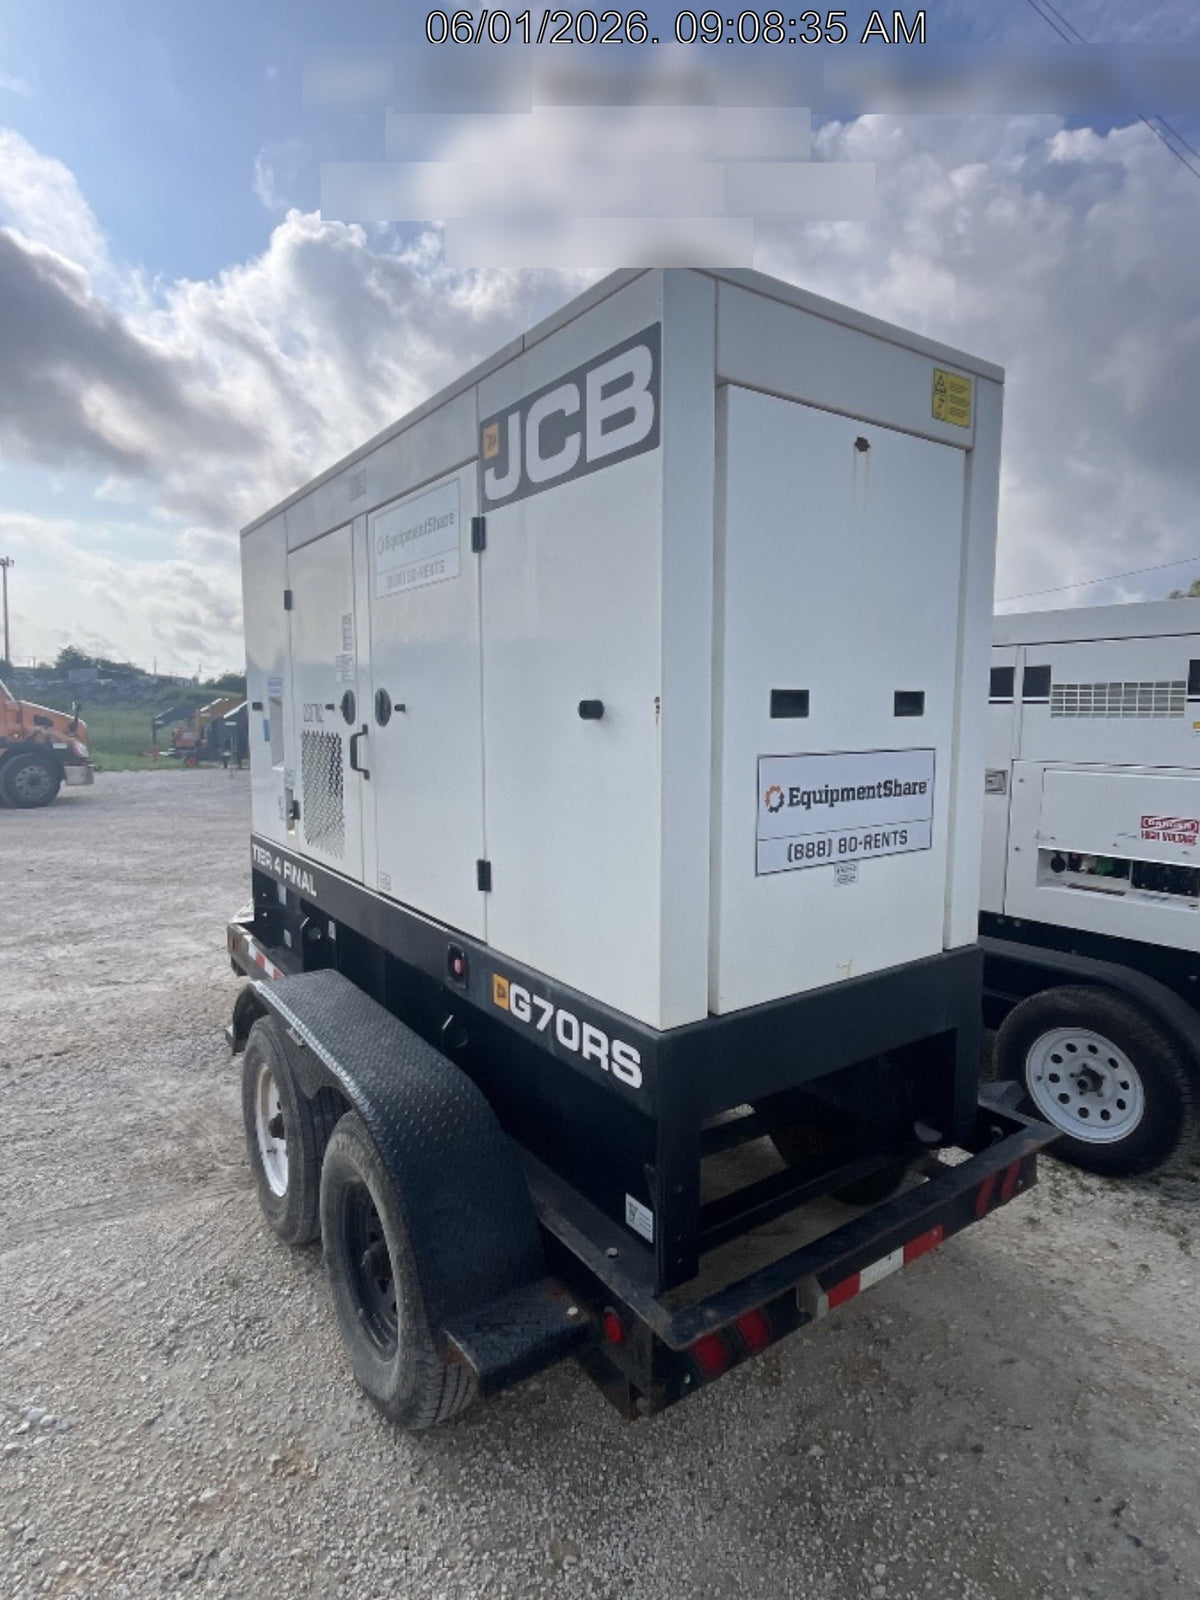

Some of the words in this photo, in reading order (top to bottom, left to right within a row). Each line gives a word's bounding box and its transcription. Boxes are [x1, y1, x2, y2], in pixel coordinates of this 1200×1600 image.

[485, 344, 655, 500] JCB
[788, 778, 928, 810] EquipmentShare
[252, 844, 273, 871] TIER
[274, 856, 282, 876] 4
[283, 860, 318, 897] FINAL
[787, 838, 833, 863] (888)
[838, 829, 908, 855] 80-RENTS
[509, 982, 643, 1089] G70RS
